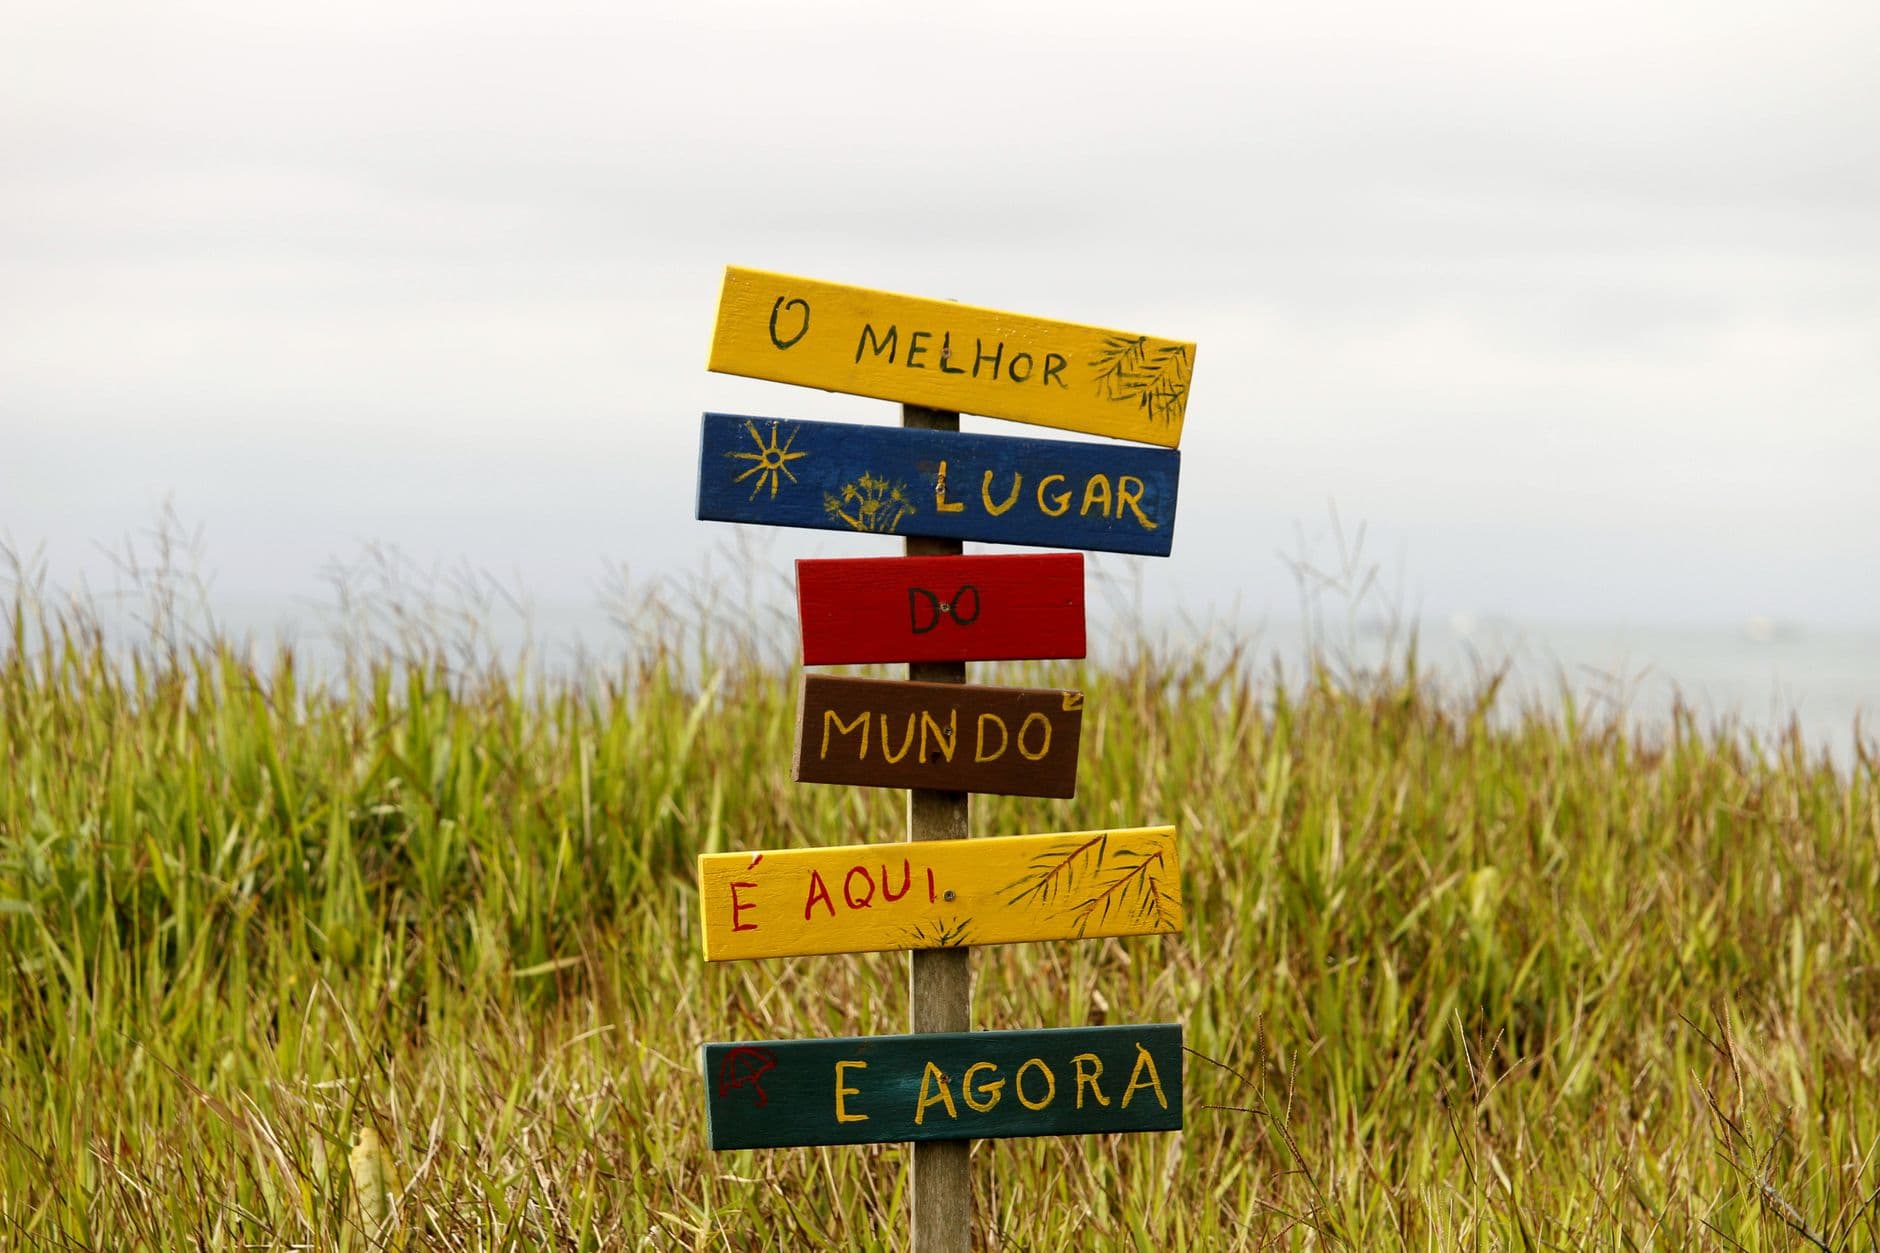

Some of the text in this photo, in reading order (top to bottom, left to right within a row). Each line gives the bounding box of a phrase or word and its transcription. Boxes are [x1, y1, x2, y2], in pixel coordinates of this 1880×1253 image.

[768, 295, 1069, 389] O MELHOR
[937, 460, 1159, 530] LUGAR
[908, 584, 980, 634] DO
[820, 708, 1052, 764] MUNDO
[730, 855, 936, 932] É AQUI
[834, 1042, 1168, 1125] E AGORA
